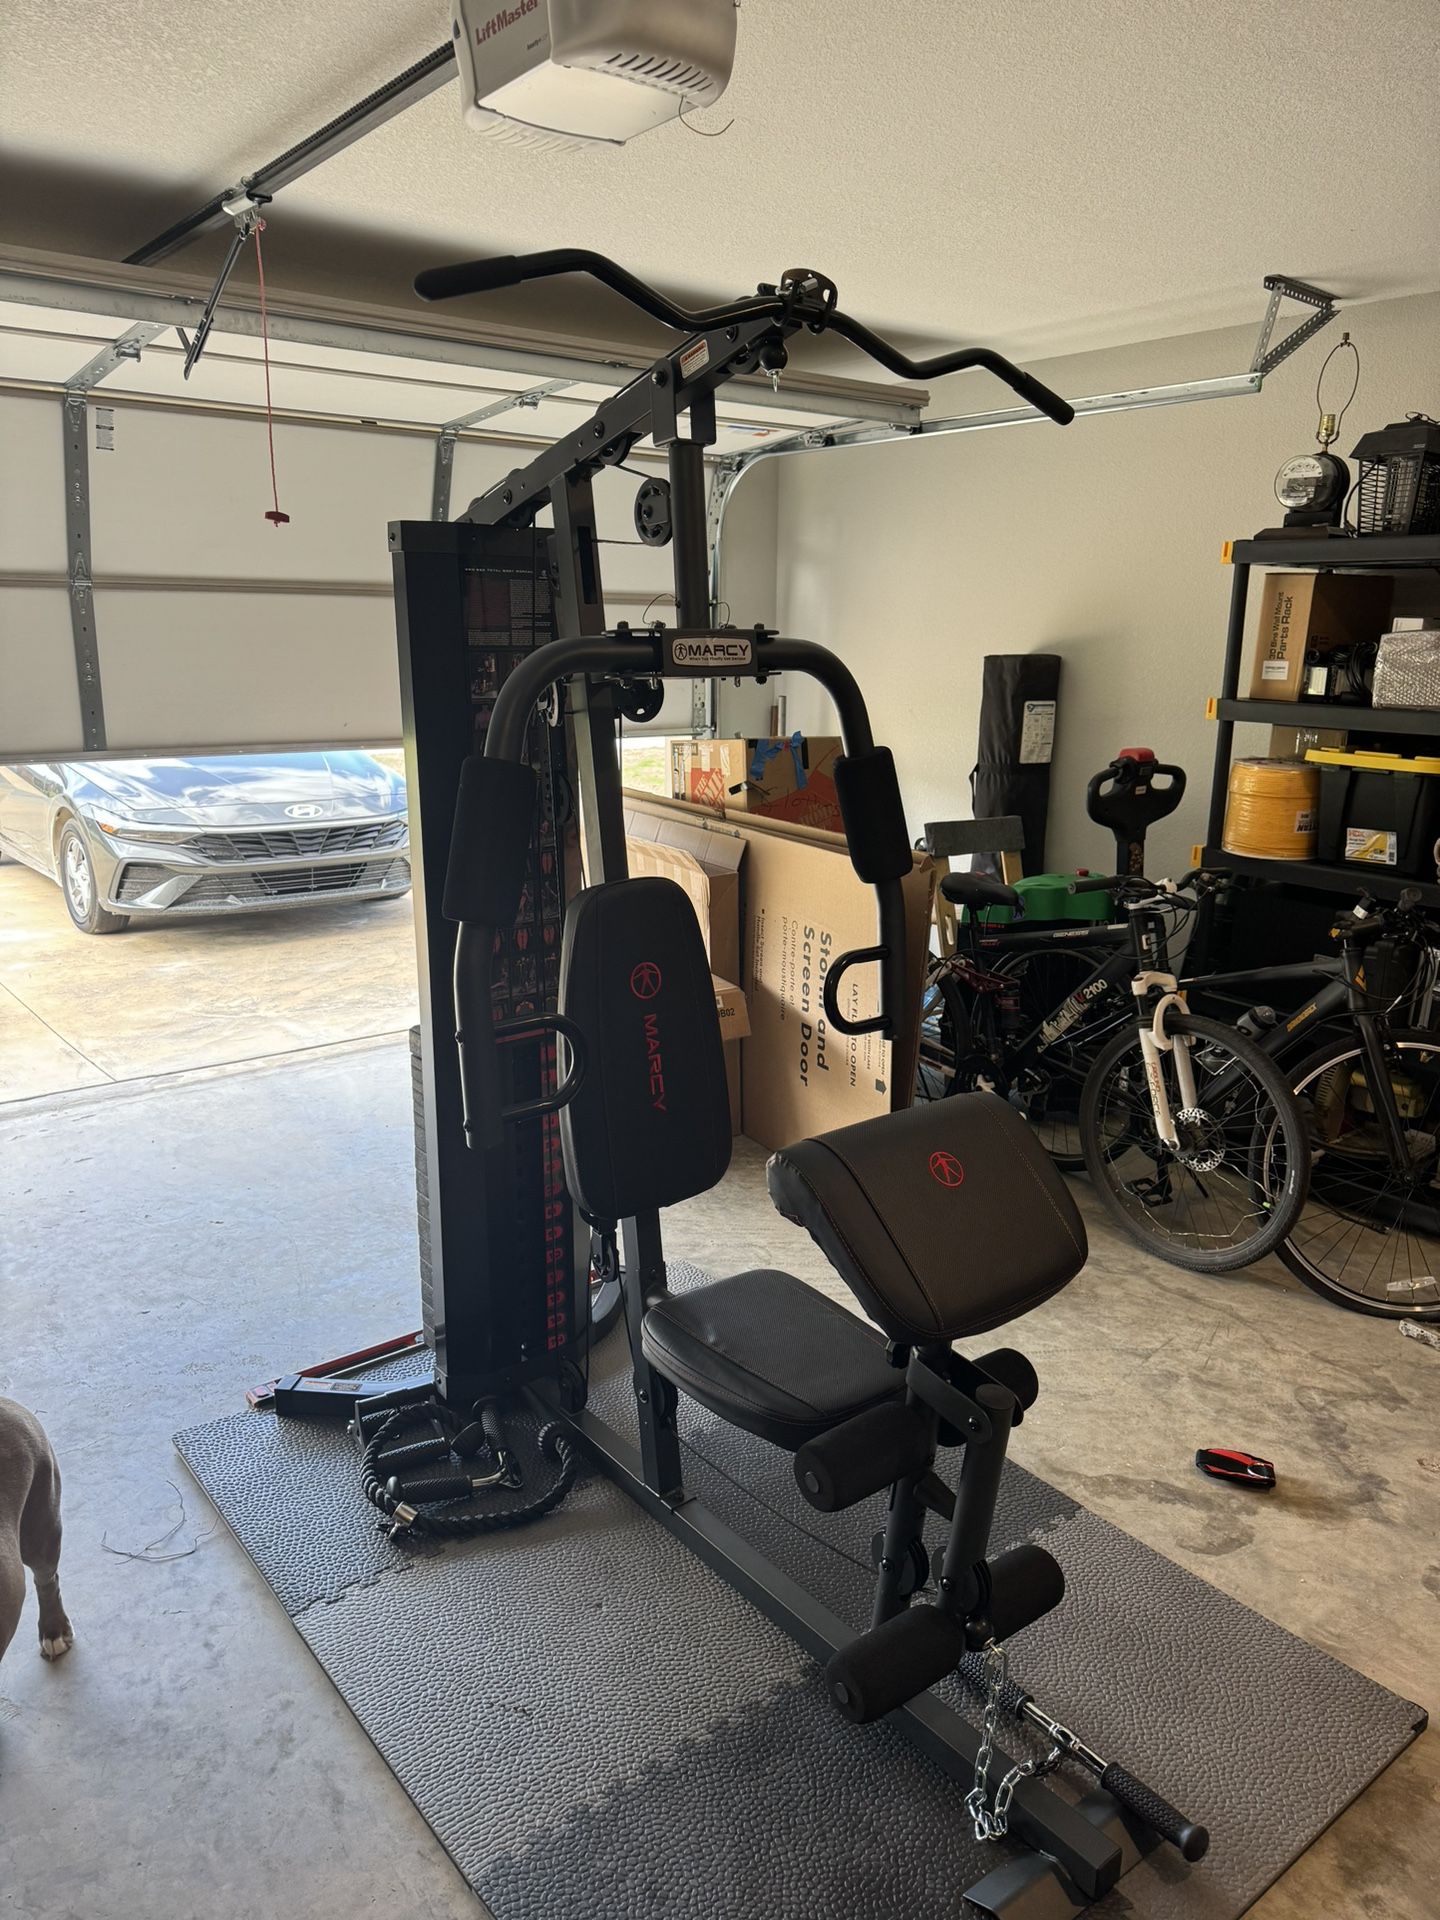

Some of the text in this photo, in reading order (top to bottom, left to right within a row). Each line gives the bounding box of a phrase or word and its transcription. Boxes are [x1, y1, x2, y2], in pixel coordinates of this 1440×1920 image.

[475, 0, 540, 46] LiftMaster
[1281, 596, 1294, 625] Rack
[688, 644, 749, 657] MARCY
[1276, 626, 1290, 660] Parts
[780, 916, 788, 1021] porte-moustiquaire
[789, 920, 799, 992] Contre-porte
[800, 925, 815, 1087] Screen Door
[851, 983, 859, 1006] LAY
[644, 1013, 668, 1111] MARCY
[816, 1018, 830, 1071] and
[850, 1036, 857, 1052] TO
